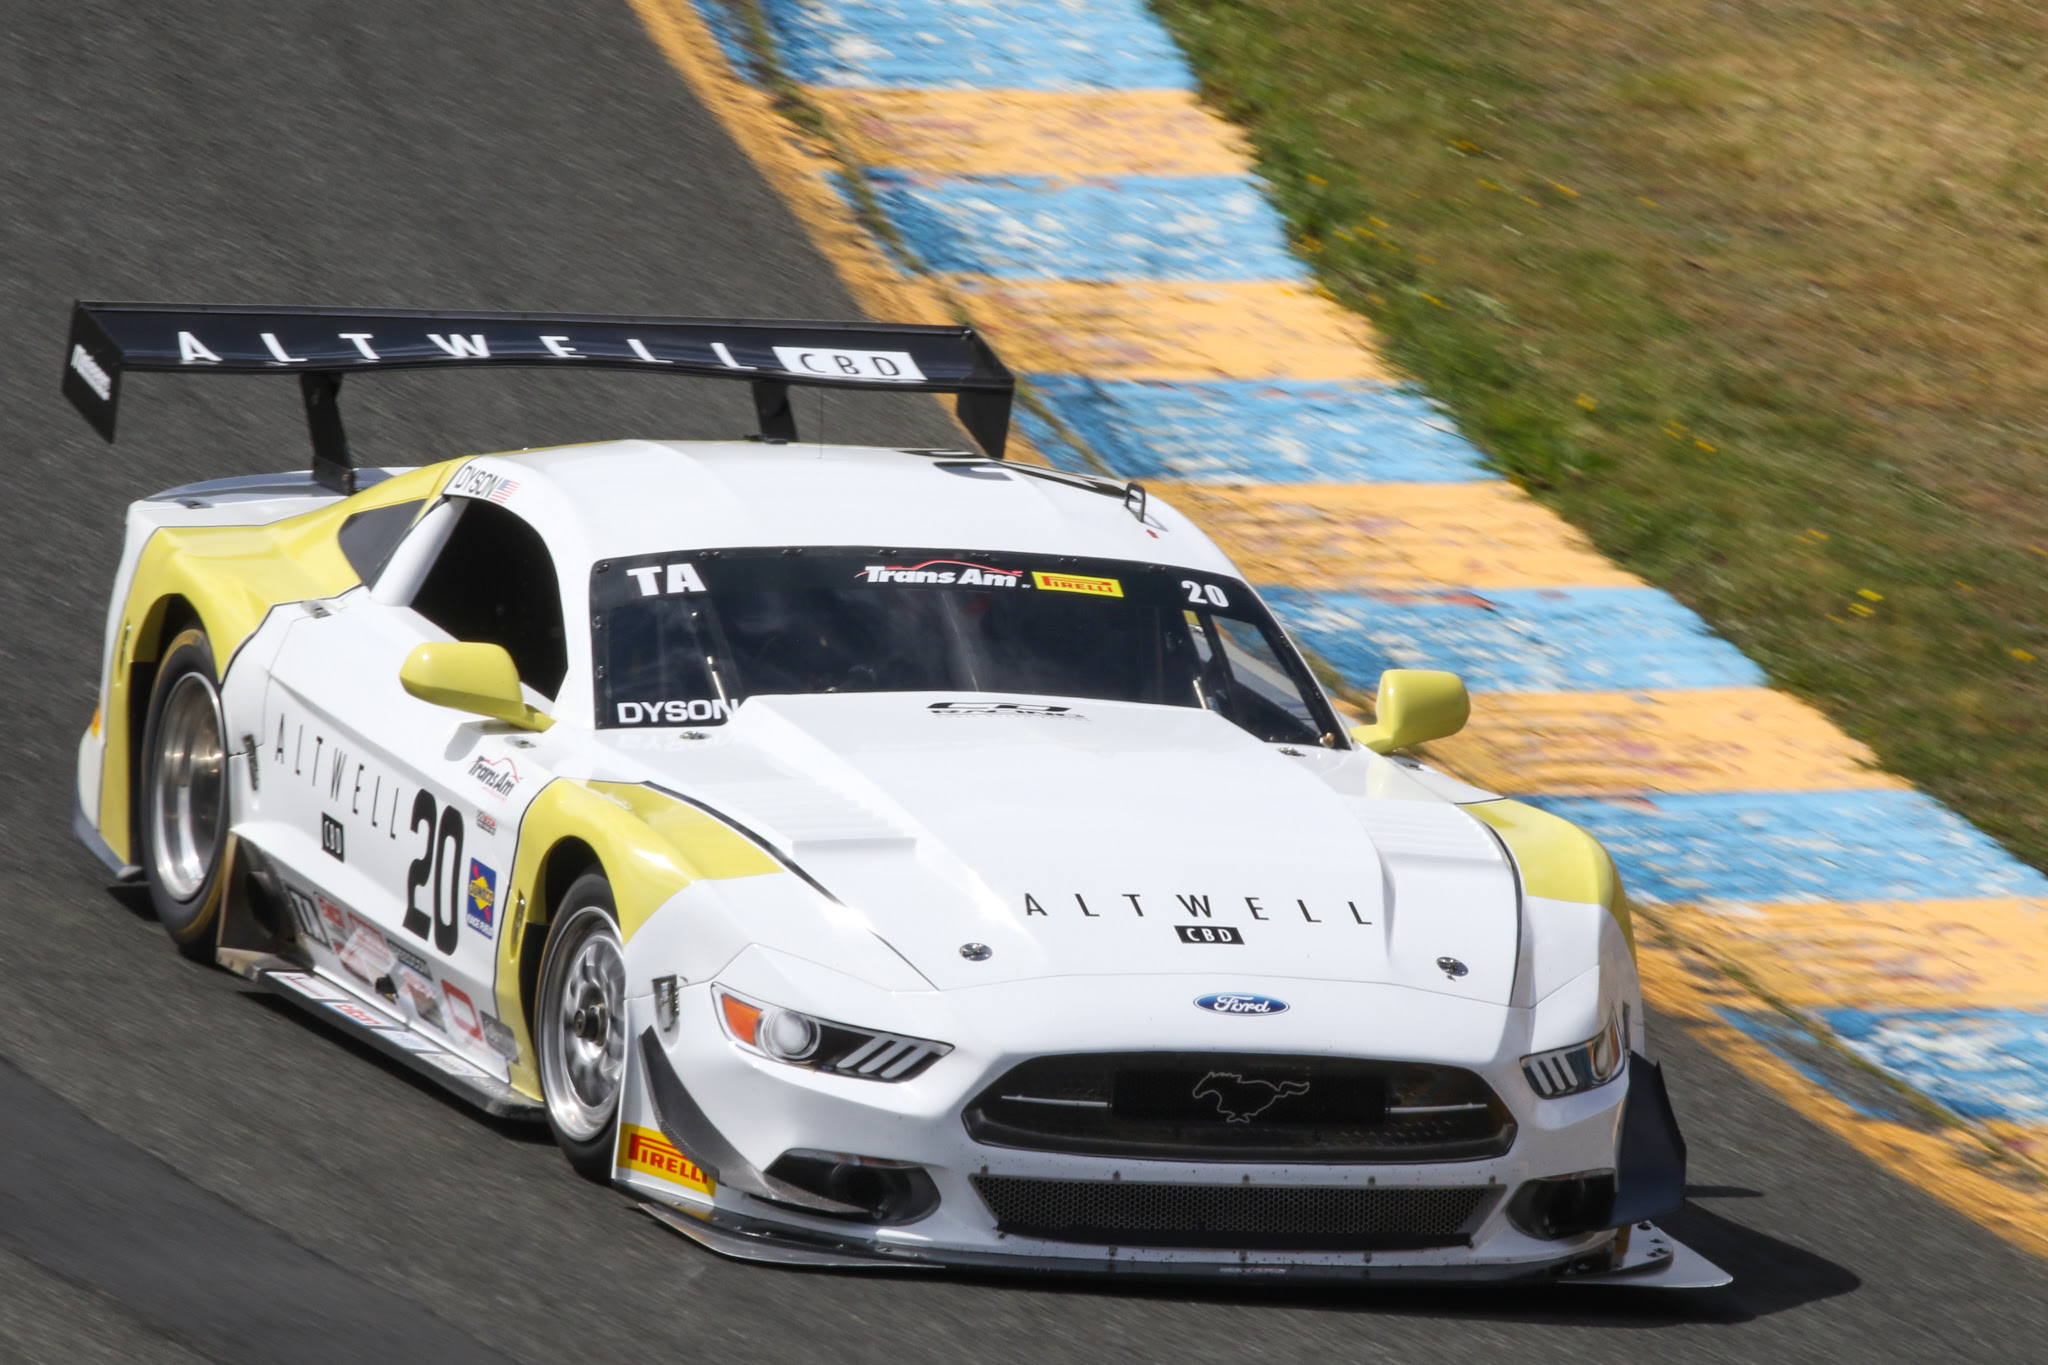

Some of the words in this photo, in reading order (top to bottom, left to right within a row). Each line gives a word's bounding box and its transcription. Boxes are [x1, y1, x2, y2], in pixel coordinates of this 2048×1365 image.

[178, 331, 756, 370] ALTWELL
[799, 353, 901, 376] CBD
[454, 465, 504, 498] DYSON
[626, 563, 707, 597] TA
[1041, 575, 1114, 593] PIRELLI
[1181, 579, 1229, 607] 20
[617, 698, 739, 724] DYSON
[275, 713, 400, 840] ALTWELL
[402, 788, 464, 956] 20
[1024, 893, 1372, 925] ALTWELL
[1186, 927, 1234, 943] CBD
[1213, 995, 1271, 1014] Ford
[628, 1132, 709, 1184] PIRELLI
